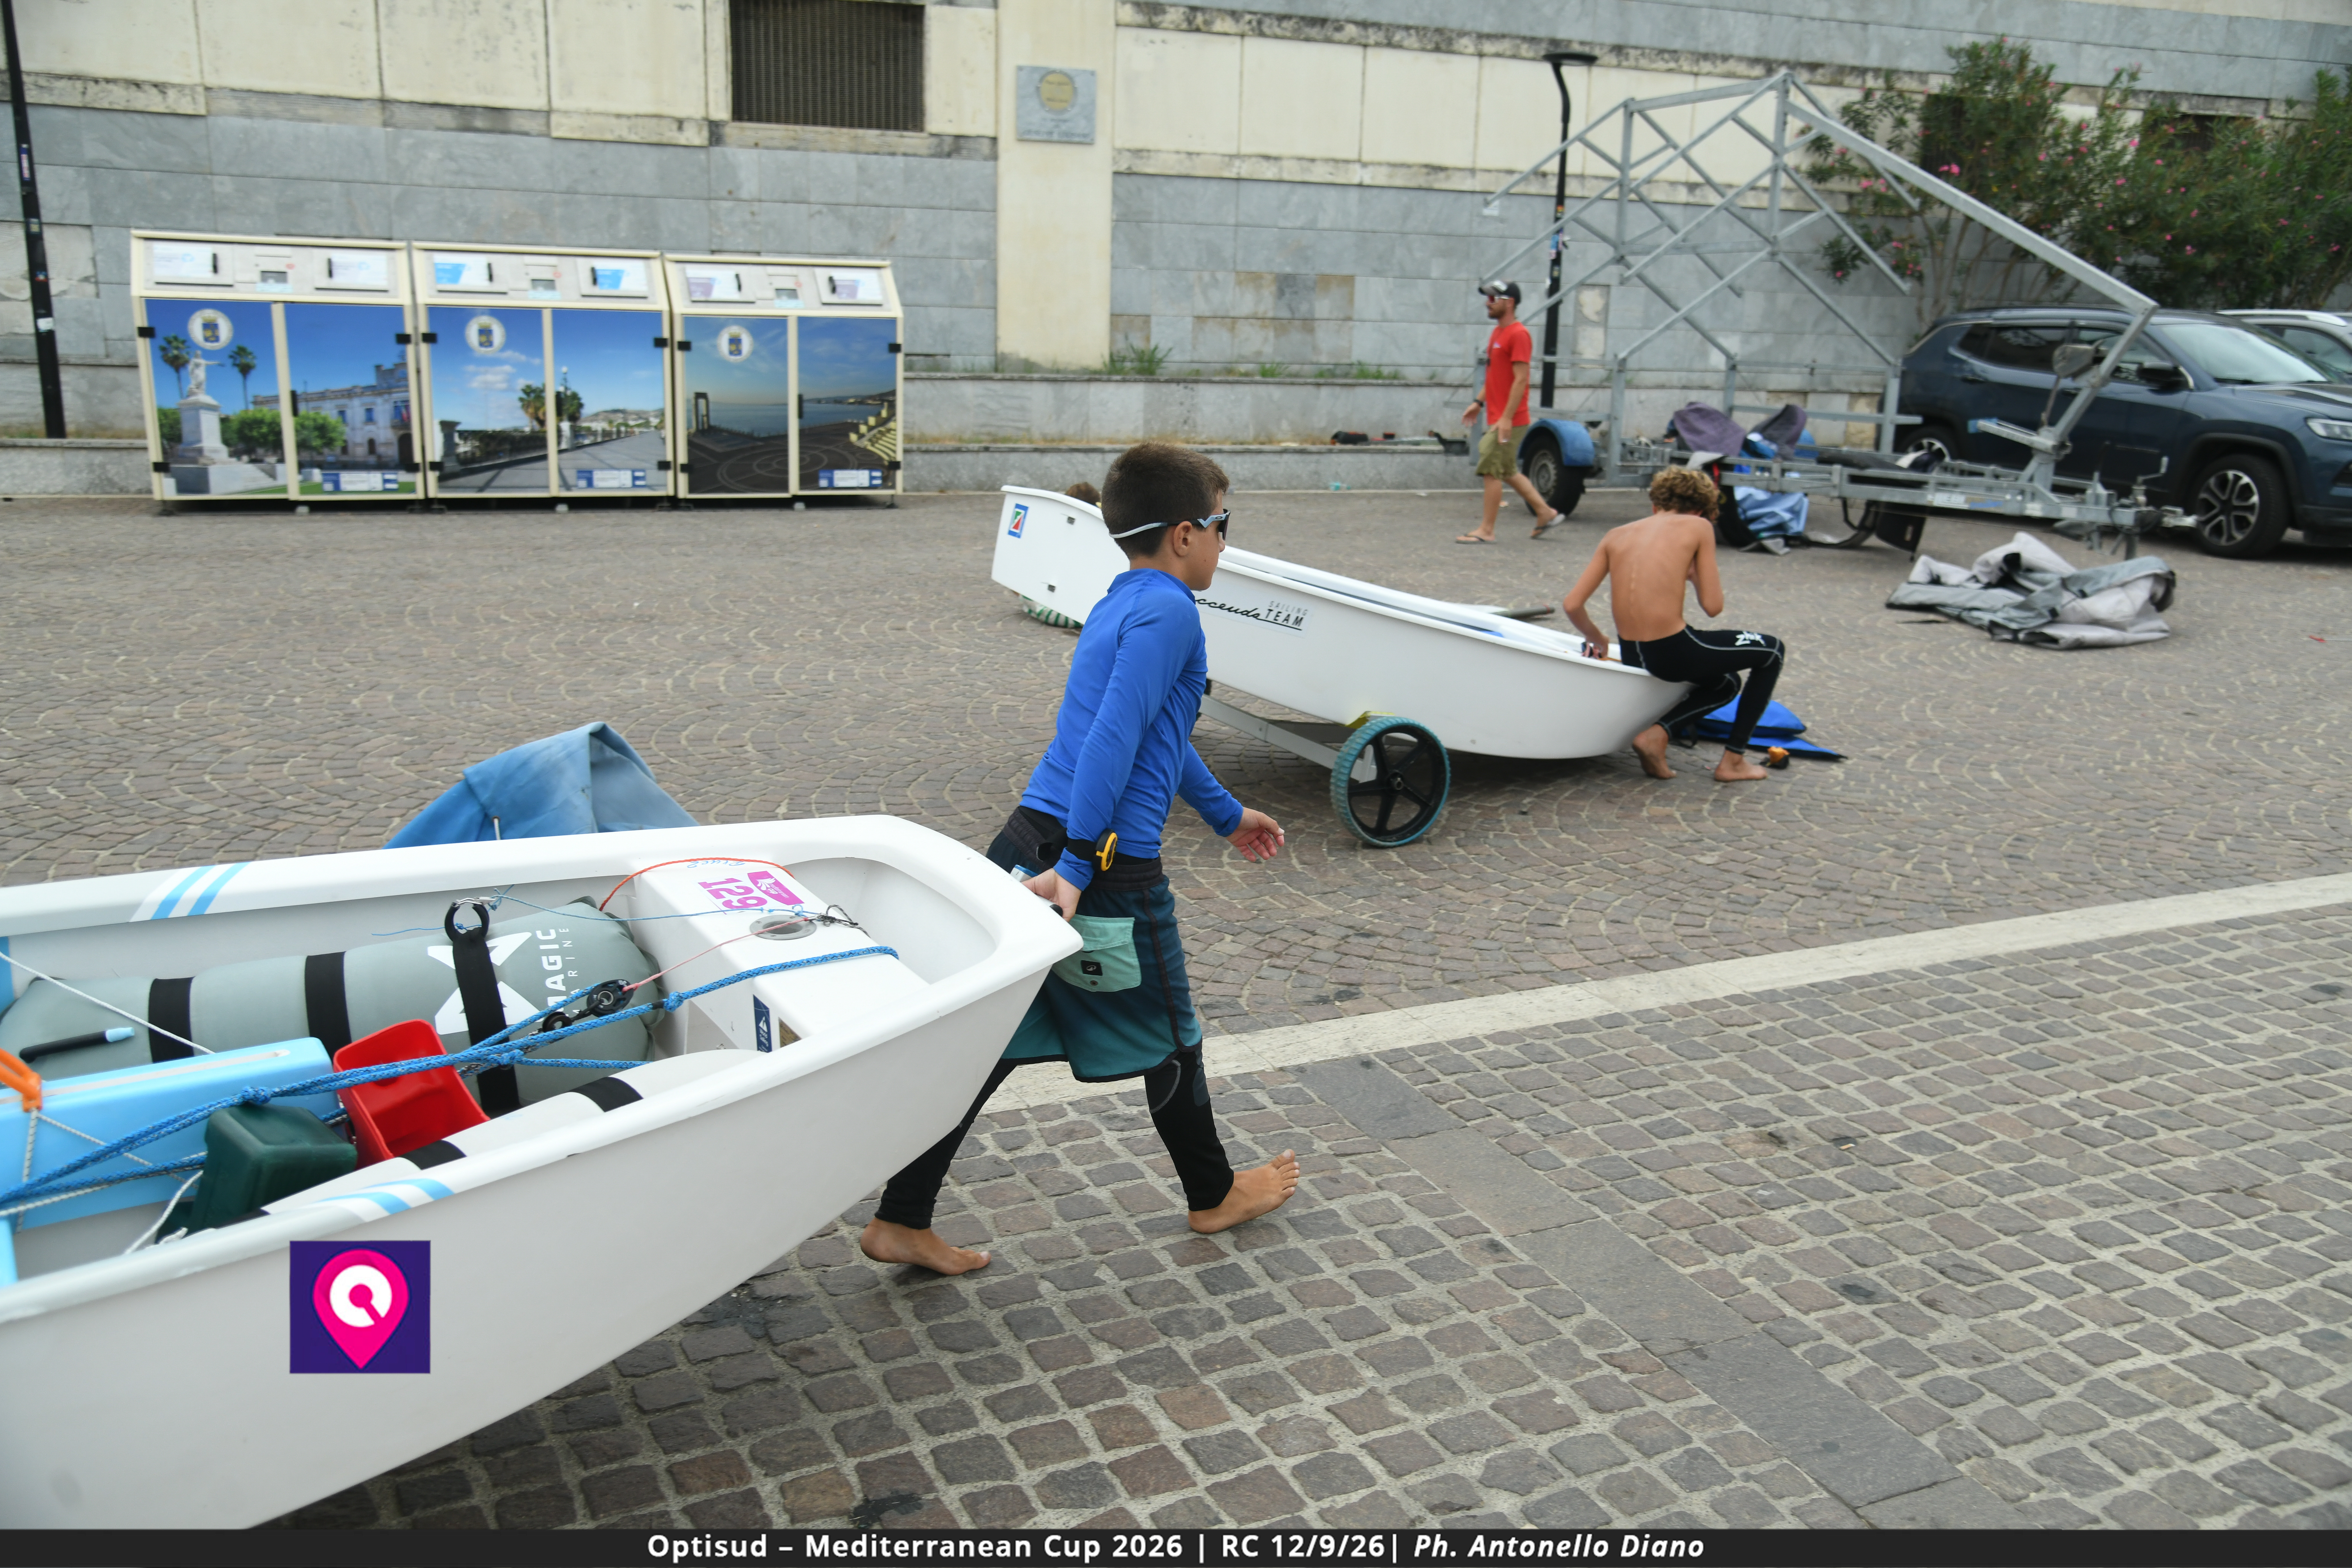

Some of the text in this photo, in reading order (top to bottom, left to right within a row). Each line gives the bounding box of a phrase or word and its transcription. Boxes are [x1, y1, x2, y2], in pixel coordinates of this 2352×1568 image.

[1269, 601, 1308, 616] SAILING
[1265, 609, 1304, 627] TEAM
[698, 878, 767, 909] 129
